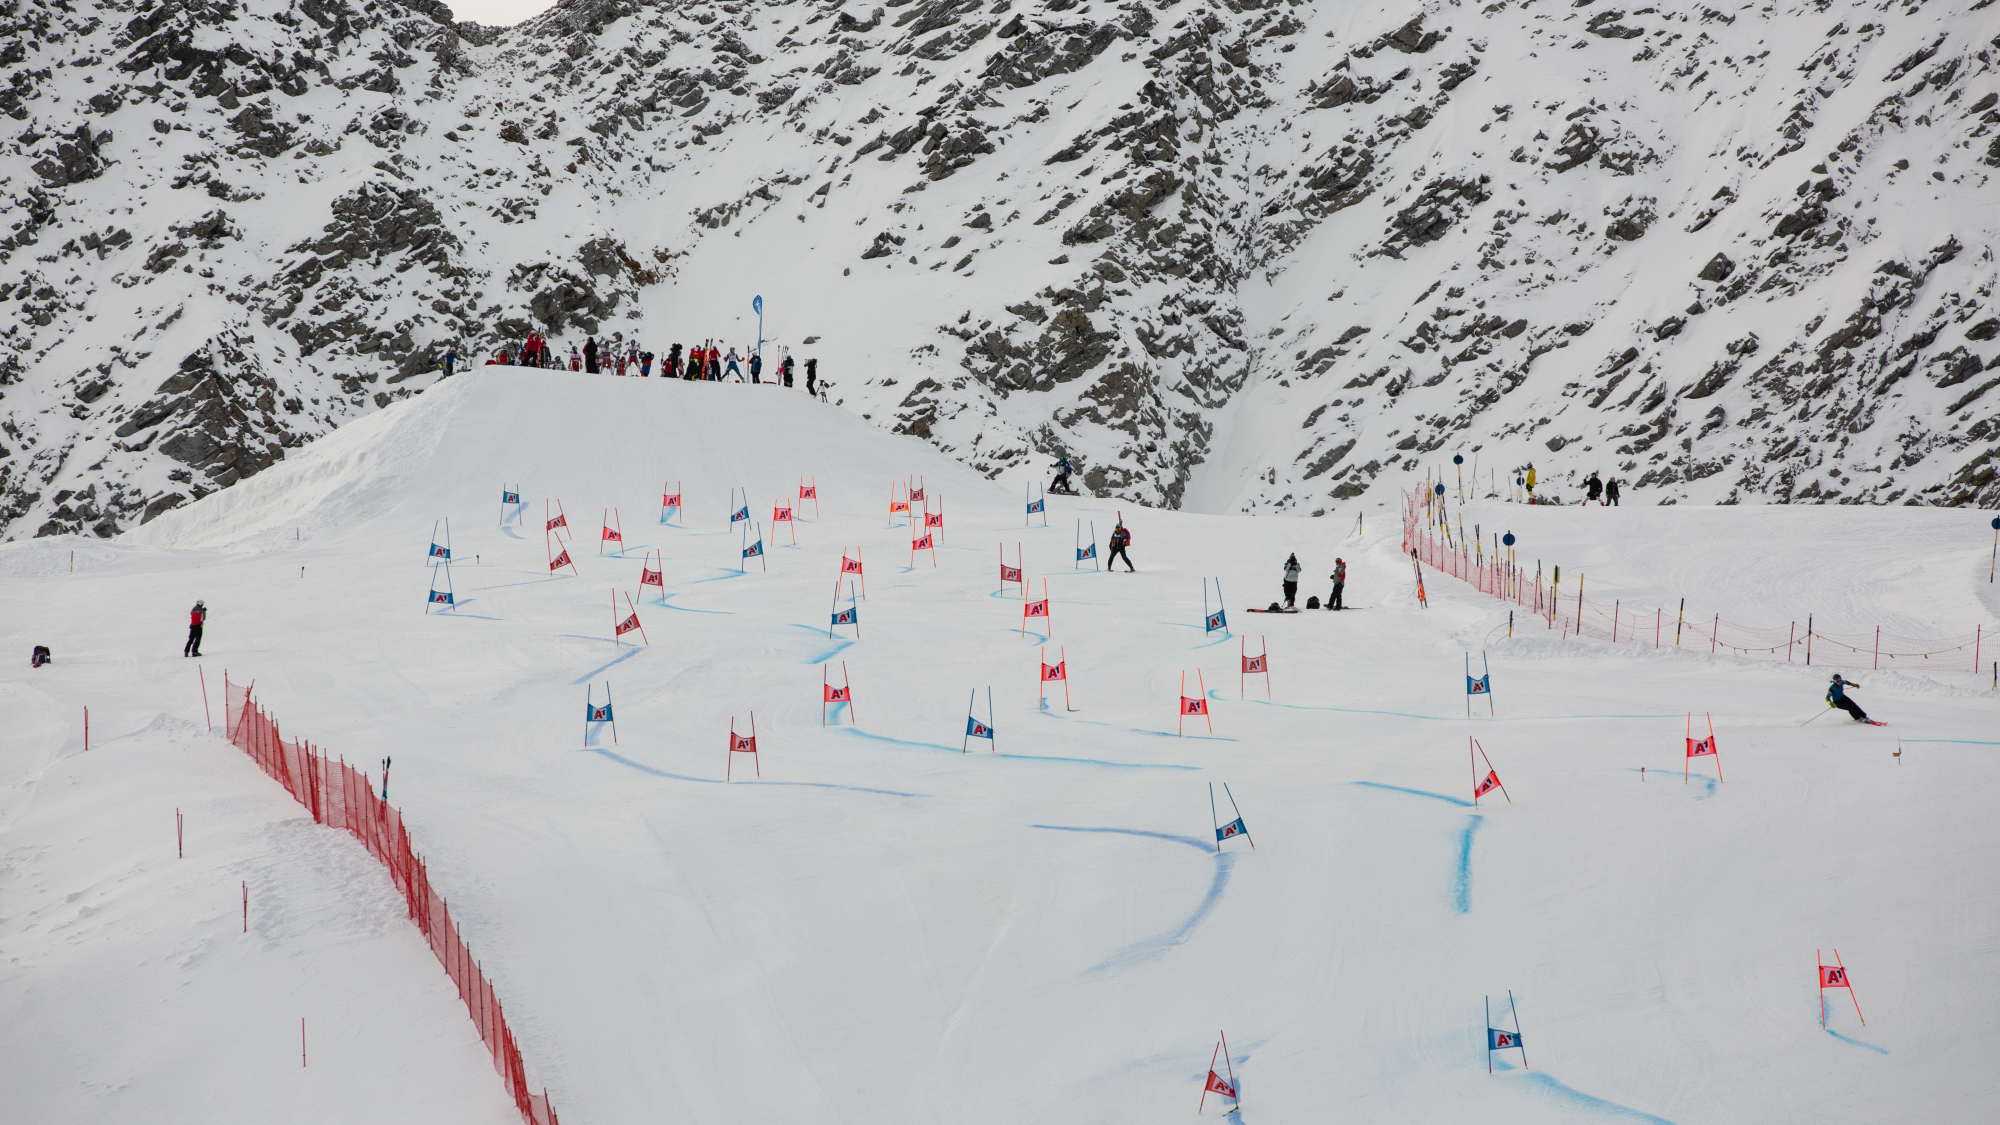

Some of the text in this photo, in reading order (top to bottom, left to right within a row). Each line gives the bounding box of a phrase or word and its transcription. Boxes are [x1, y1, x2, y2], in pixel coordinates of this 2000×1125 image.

[805, 489, 813, 497] A1
[913, 491, 920, 499] A1
[668, 497, 676, 505] A1
[1031, 503, 1040, 512] A1
[736, 509, 744, 520] A1
[779, 510, 788, 520] A1
[553, 519, 561, 528] A1
[930, 516, 939, 525] A1
[918, 538, 928, 549] A1
[435, 548, 446, 556] A1
[749, 546, 758, 555] A1
[1082, 547, 1090, 558] A1
[556, 556, 564, 566] A1
[846, 563, 857, 571] A1
[647, 574, 658, 582] A1
[1007, 571, 1016, 579] A1
[1031, 602, 1043, 615] A1
[839, 611, 850, 622] A1
[623, 619, 632, 631] A1
[1211, 616, 1219, 628] A1
[1249, 660, 1260, 670] A1
[1048, 666, 1060, 678] A1
[1473, 681, 1484, 692] A1
[831, 689, 843, 699] A1
[1188, 702, 1200, 713] A1
[594, 709, 606, 719] A1
[974, 725, 986, 735] A1
[737, 740, 749, 749] A1
[1694, 741, 1708, 754] A1
[1481, 778, 1492, 792] A1
[1225, 824, 1237, 836] A1
[1827, 970, 1842, 984] A1
[1497, 1034, 1512, 1046] A1
